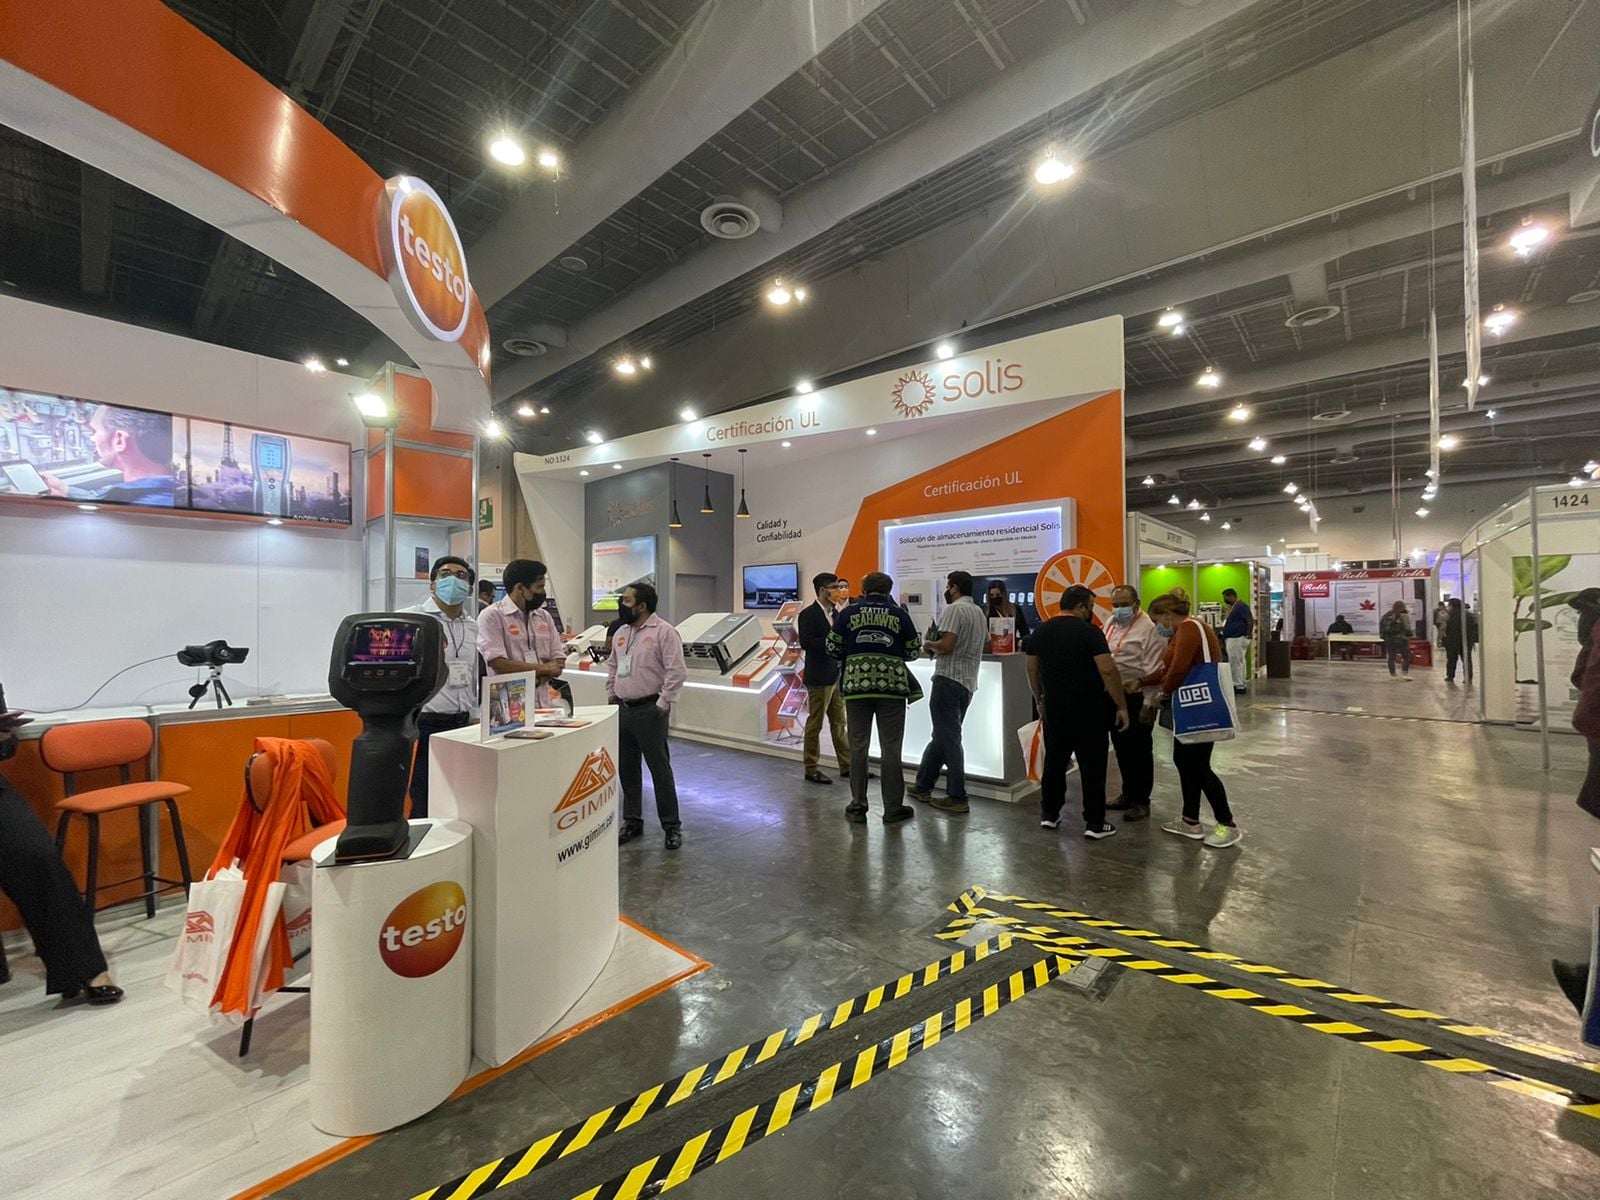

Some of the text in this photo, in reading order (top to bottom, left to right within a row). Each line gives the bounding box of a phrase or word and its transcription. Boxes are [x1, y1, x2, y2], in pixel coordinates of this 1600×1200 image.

[400, 214, 465, 303] testo
[943, 359, 1023, 401] solis
[706, 411, 820, 441] Certificación UL
[924, 471, 1022, 498] Certificación UL
[1553, 494, 1589, 508] 1424
[756, 518, 787, 530] Calidad y
[899, 535, 926, 544] Solución
[937, 528, 995, 541] almacenamiento
[996, 523, 1039, 535] residencial
[756, 528, 802, 543] Confiabilidad
[860, 606, 890, 615] SEATTLE
[850, 613, 900, 634] SEAHAWKS
[382, 904, 466, 952] testo
